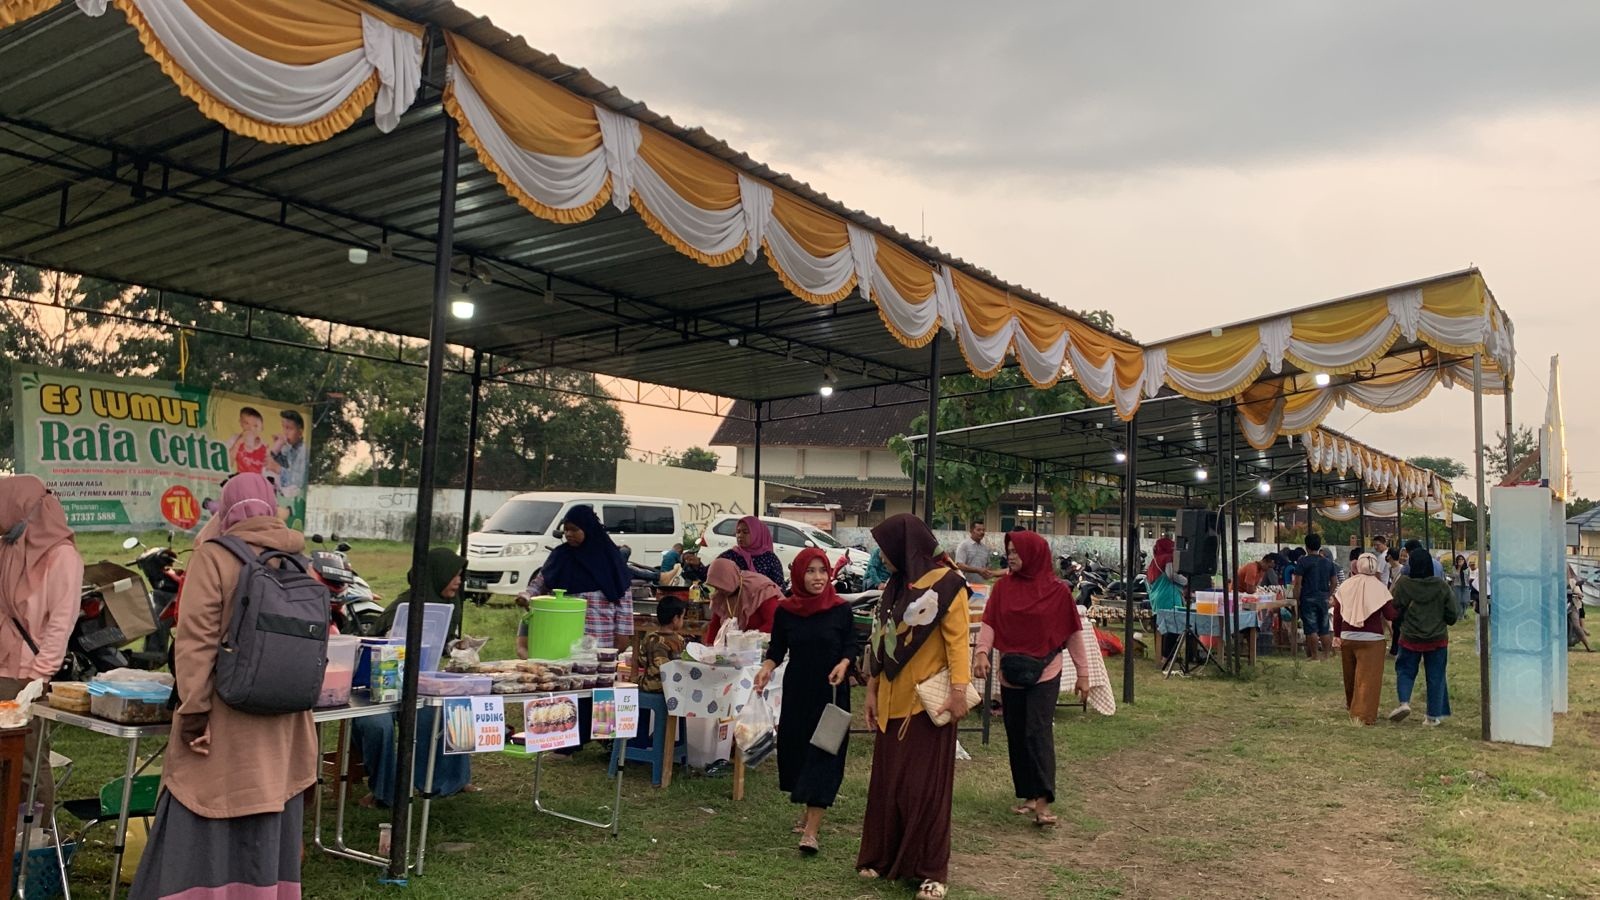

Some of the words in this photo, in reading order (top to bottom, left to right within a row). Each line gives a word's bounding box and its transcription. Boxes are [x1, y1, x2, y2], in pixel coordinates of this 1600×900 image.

[40, 384, 82, 416] ES
[90, 388, 200, 427] LUMUT
[39, 420, 138, 463] Rafa
[150, 428, 231, 473] Cetta
[166, 495, 195, 520] 7K
[484, 702, 494, 711] ES
[617, 704, 637, 712] LUMUT
[475, 713, 504, 723] PUDING
[478, 734, 502, 746] 2.000
